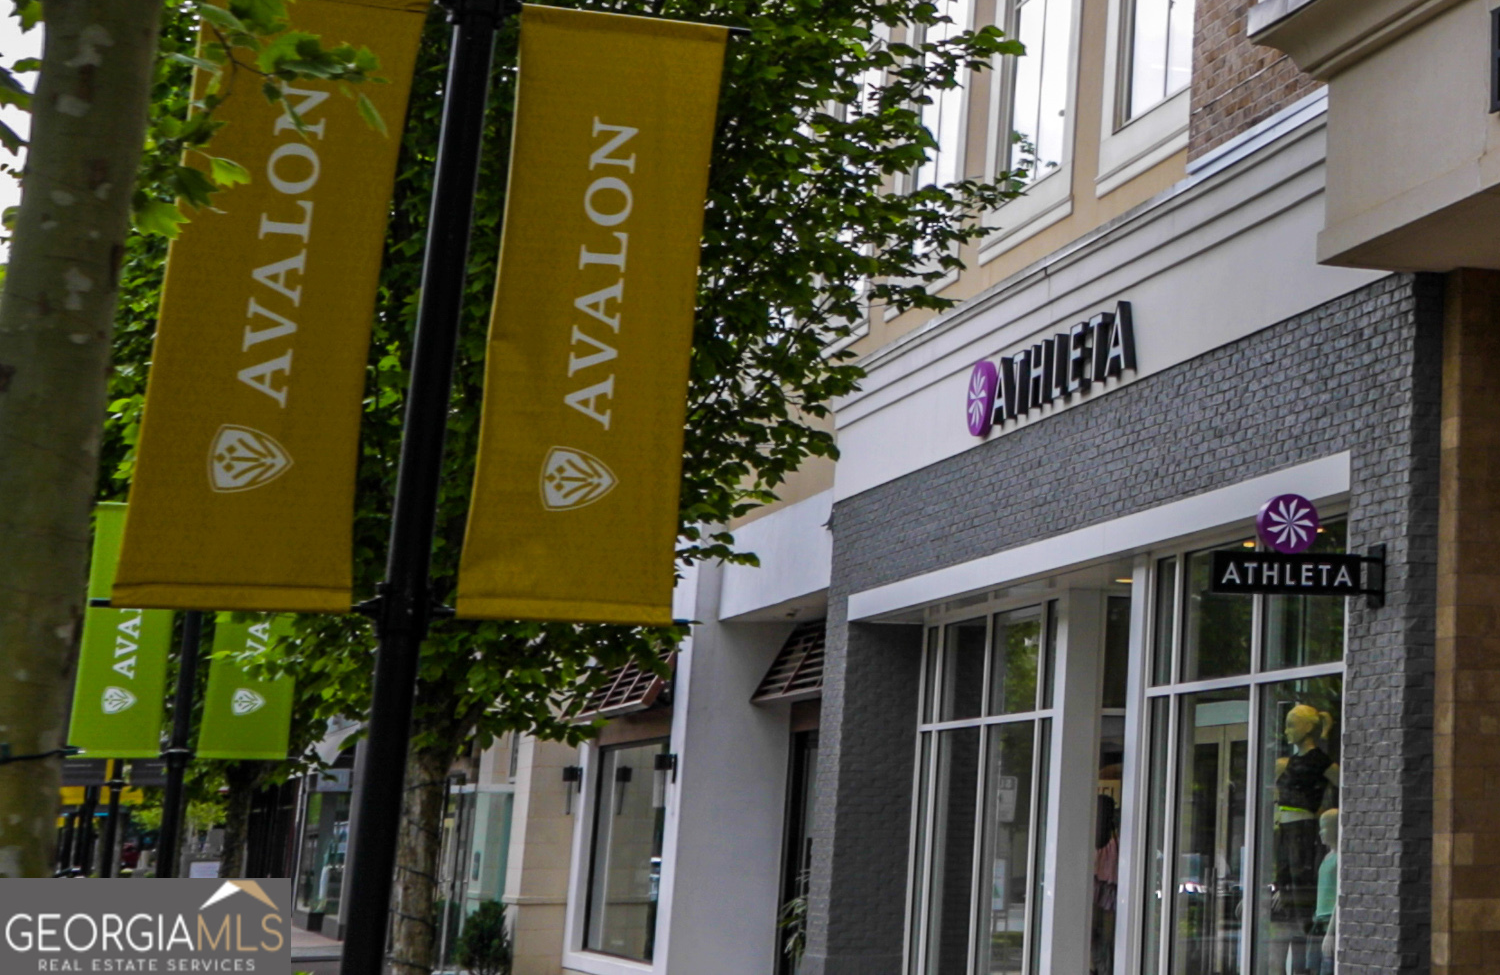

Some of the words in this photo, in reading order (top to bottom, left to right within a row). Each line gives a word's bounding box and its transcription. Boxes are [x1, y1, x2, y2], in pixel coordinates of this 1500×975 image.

[236, 80, 330, 409] AVALON
[563, 116, 640, 430] AVALON
[990, 300, 1138, 425] ATHLETA
[1221, 561, 1353, 588] ATHLETA
